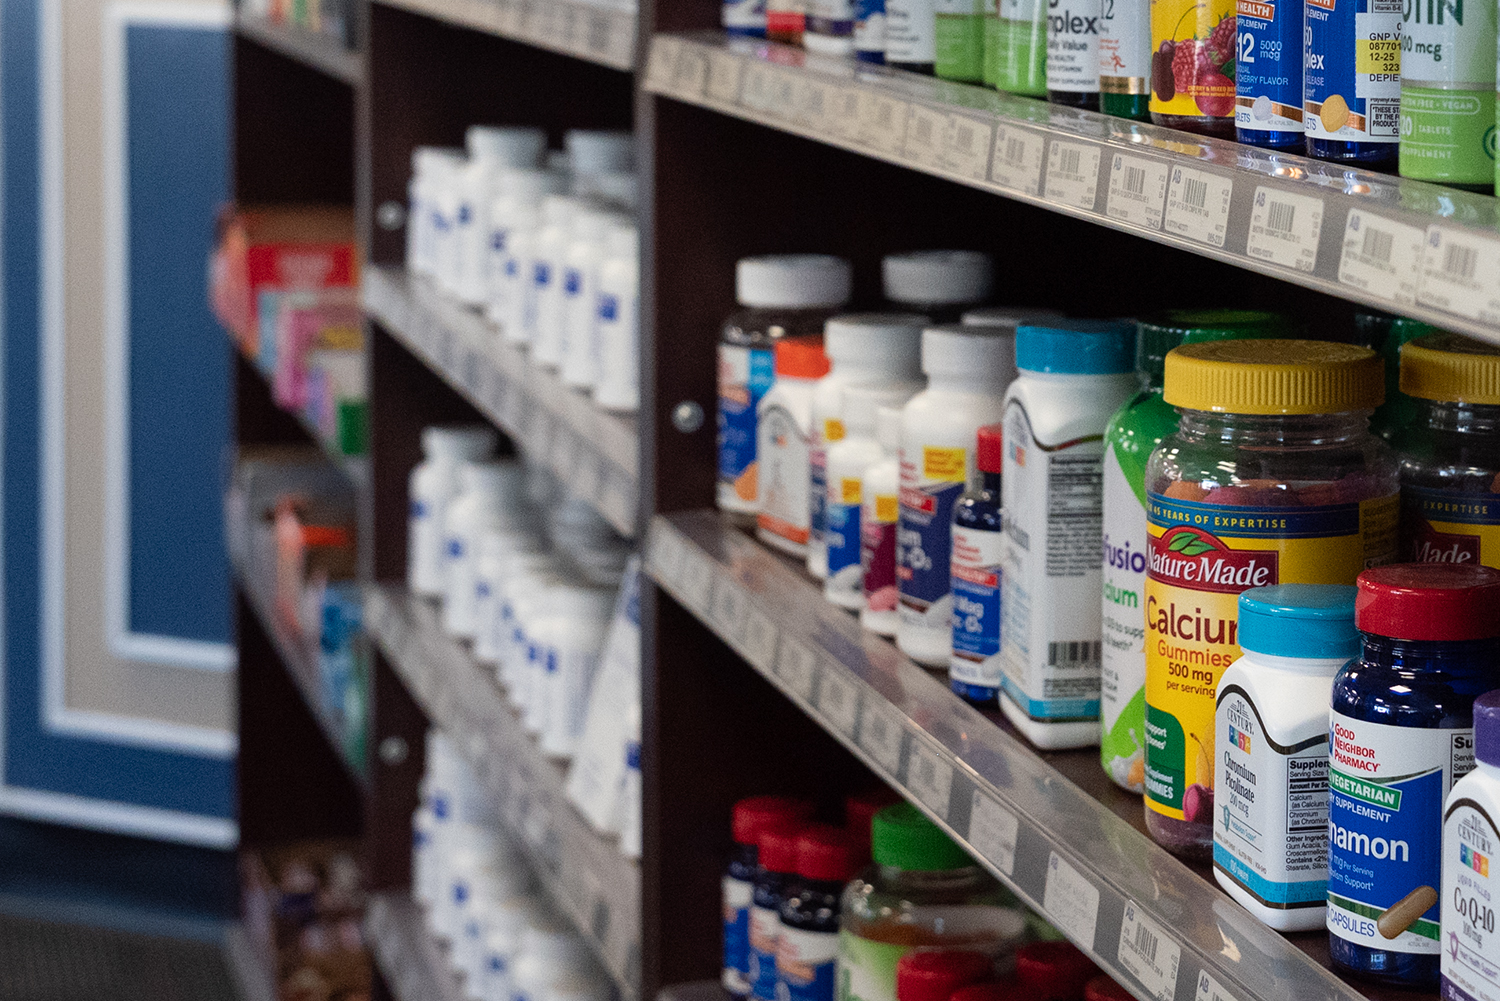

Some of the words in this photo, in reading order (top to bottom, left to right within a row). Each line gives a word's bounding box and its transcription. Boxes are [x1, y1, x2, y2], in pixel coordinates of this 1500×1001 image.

[1240, 1, 1271, 18] HEALTH
[1260, 40, 1283, 52] 5000
[1369, 32, 1391, 41] GNP
[1260, 50, 1281, 62] mcg
[1370, 52, 1395, 61] 12-25
[1415, 42, 1443, 62] mcg
[1383, 63, 1400, 72] 323
[1259, 76, 1289, 86] FLAVOR
[1442, 100, 1474, 111] VEGAN
[1418, 124, 1450, 136] TABLETS
[1423, 500, 1489, 515] EXPERTISE
[1163, 509, 1192, 523] YEARS
[1194, 514, 1210, 525] OF
[1214, 516, 1288, 529] EXPERTISE
[1157, 638, 1233, 668] Gummies
[1168, 661, 1190, 679] 500
[1192, 669, 1214, 686] mg
[1166, 680, 1180, 691] per
[1181, 684, 1217, 700] serving
[1334, 722, 1356, 741] GOOD
[1334, 735, 1376, 759] NEIGHBOR
[1223, 750, 1257, 787] Chromium
[1334, 748, 1380, 773] PHARMACY
[1289, 770, 1311, 778] Serving
[1224, 769, 1256, 804] Picolinate
[1331, 774, 1396, 806] VEGETARIAN
[1301, 799, 1325, 808] Calcium
[1335, 793, 1392, 824] SUPPLEMENT
[1289, 810, 1318, 818] Chromium
[1286, 834, 1303, 842] Other
[1286, 857, 1313, 865] Contains
[1333, 855, 1343, 870] mg
[1343, 860, 1352, 871] Per
[1352, 864, 1375, 878] Serving
[1453, 886, 1467, 917] Co
[1468, 896, 1496, 935] Q-10
[1331, 908, 1376, 938] CAPSULES
[1199, 974, 1210, 994] AB
